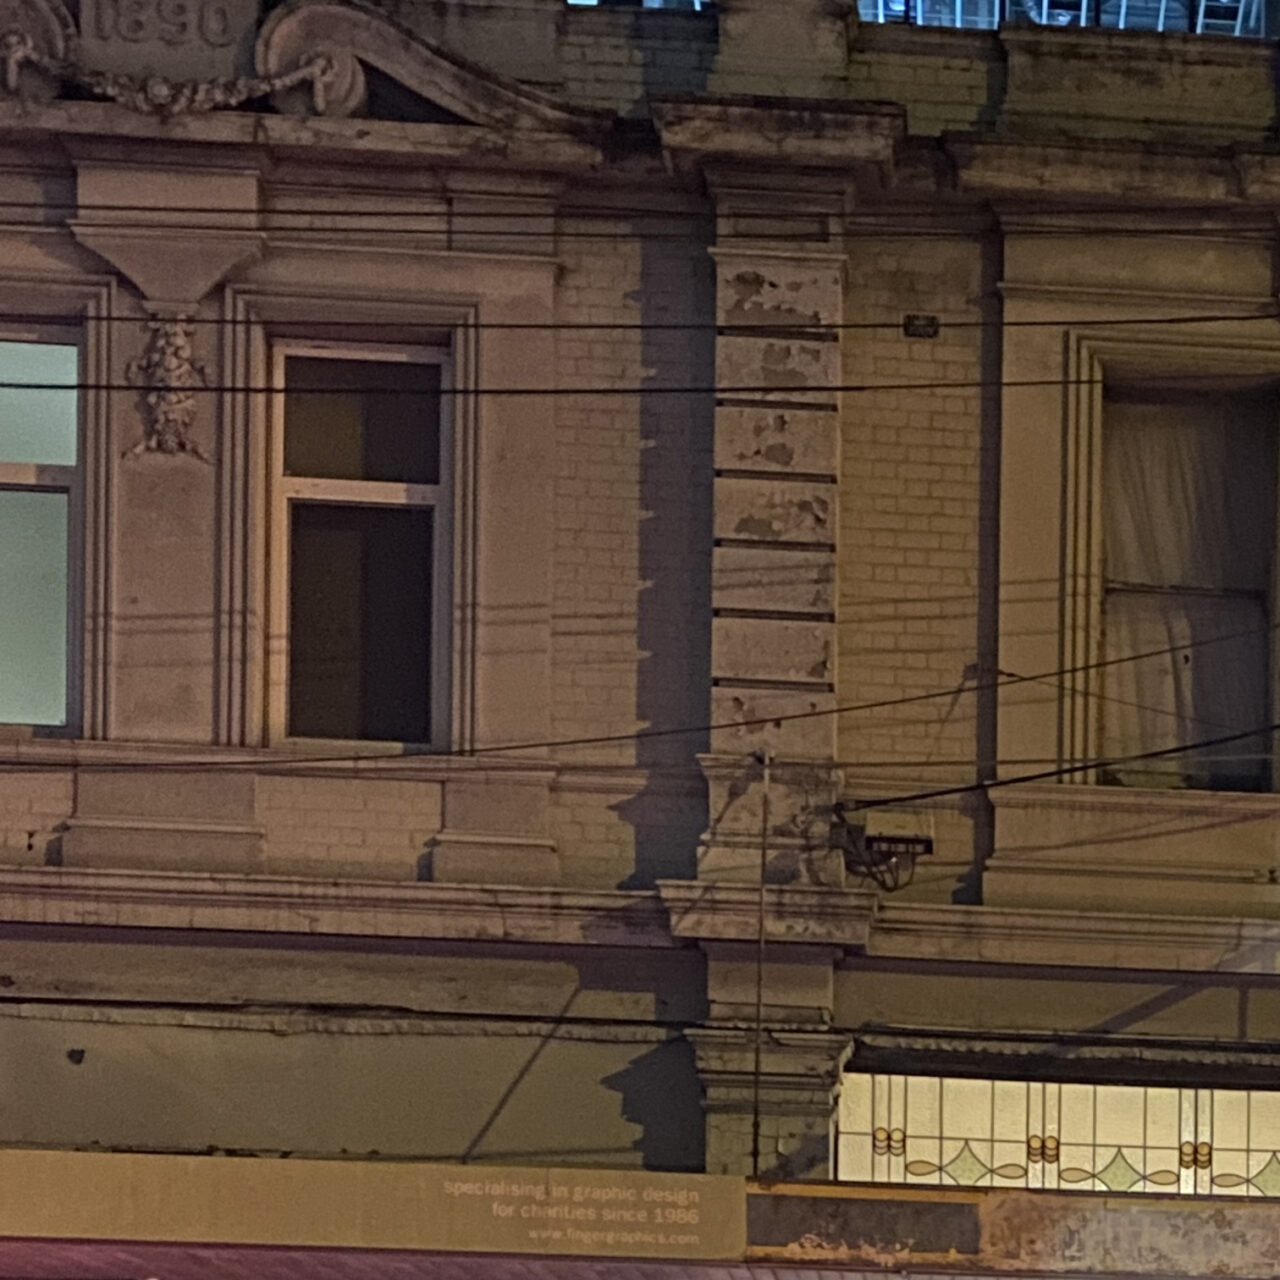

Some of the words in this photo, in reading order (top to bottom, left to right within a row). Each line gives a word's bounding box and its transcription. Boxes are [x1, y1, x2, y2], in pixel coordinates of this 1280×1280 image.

[93, 0, 236, 48] 1890
[443, 1180, 546, 1201] specialising
[551, 1184, 569, 1198] in
[572, 1185, 637, 1203] graphic
[642, 1186, 700, 1206] design
[491, 1201, 515, 1218] for
[519, 1202, 597, 1220] charities
[601, 1206, 648, 1222] since
[653, 1207, 700, 1225] 1986
[527, 1228, 700, 1245] www.fingergraphics.com
